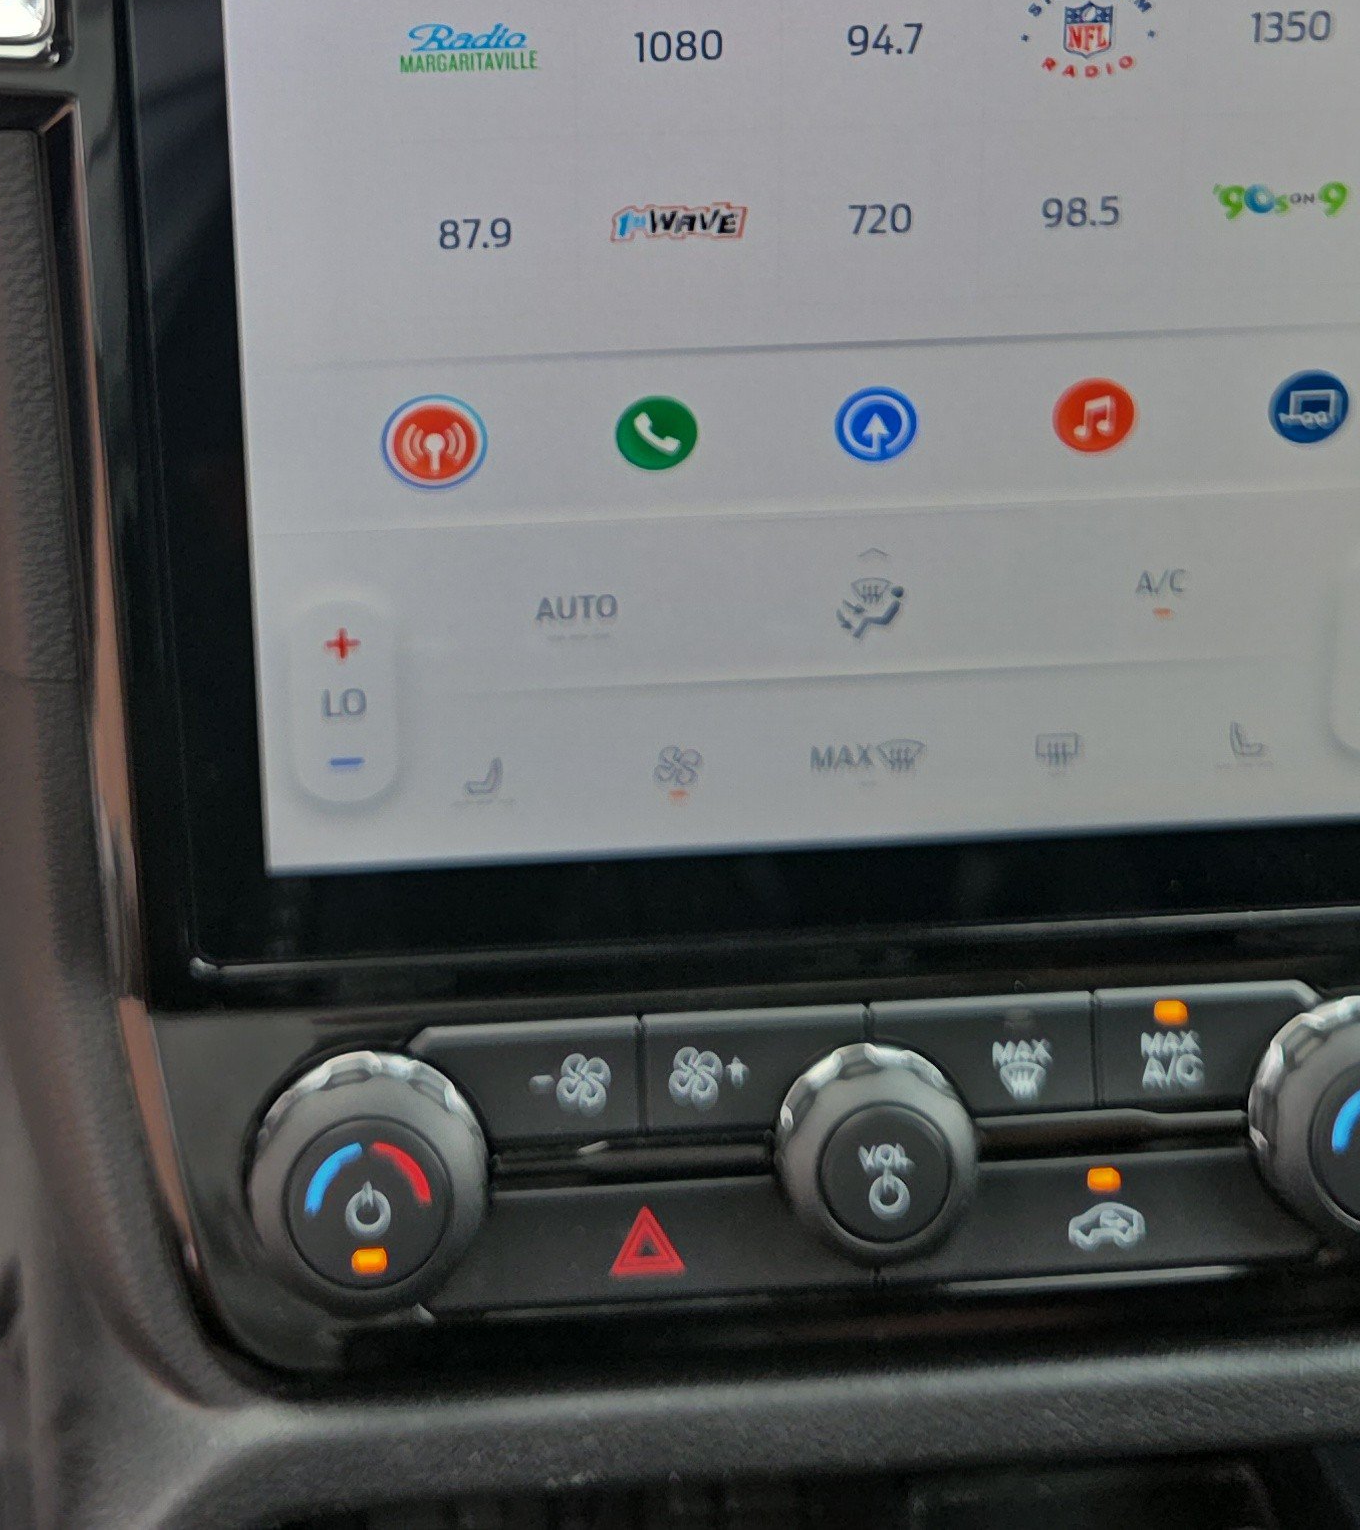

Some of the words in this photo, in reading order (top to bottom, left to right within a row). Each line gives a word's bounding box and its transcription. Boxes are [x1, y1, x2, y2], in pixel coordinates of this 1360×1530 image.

[408, 23, 527, 52] Radio
[846, 22, 924, 56] 94.7
[1068, 24, 1108, 51] NFL
[1250, 10, 1332, 44] 1350
[400, 50, 538, 72] MARGARITAVILLE
[633, 29, 724, 63] 1080
[1042, 55, 1134, 78] RADIO
[1042, 195, 1121, 228] 98.5
[1289, 192, 1315, 205] ON
[1318, 181, 1347, 218] 9
[439, 217, 512, 250] 87.9
[649, 208, 739, 234] WAVE
[848, 203, 913, 236] 720
[1136, 569, 1187, 595] A/C
[535, 592, 618, 621] AUTO
[320, 687, 368, 719] LO
[810, 743, 874, 771] MAX
[992, 1038, 1053, 1069] MAX
[1141, 1030, 1201, 1058] MAX
[1141, 1055, 1206, 1091] A/C
[858, 1142, 916, 1176] VOL
